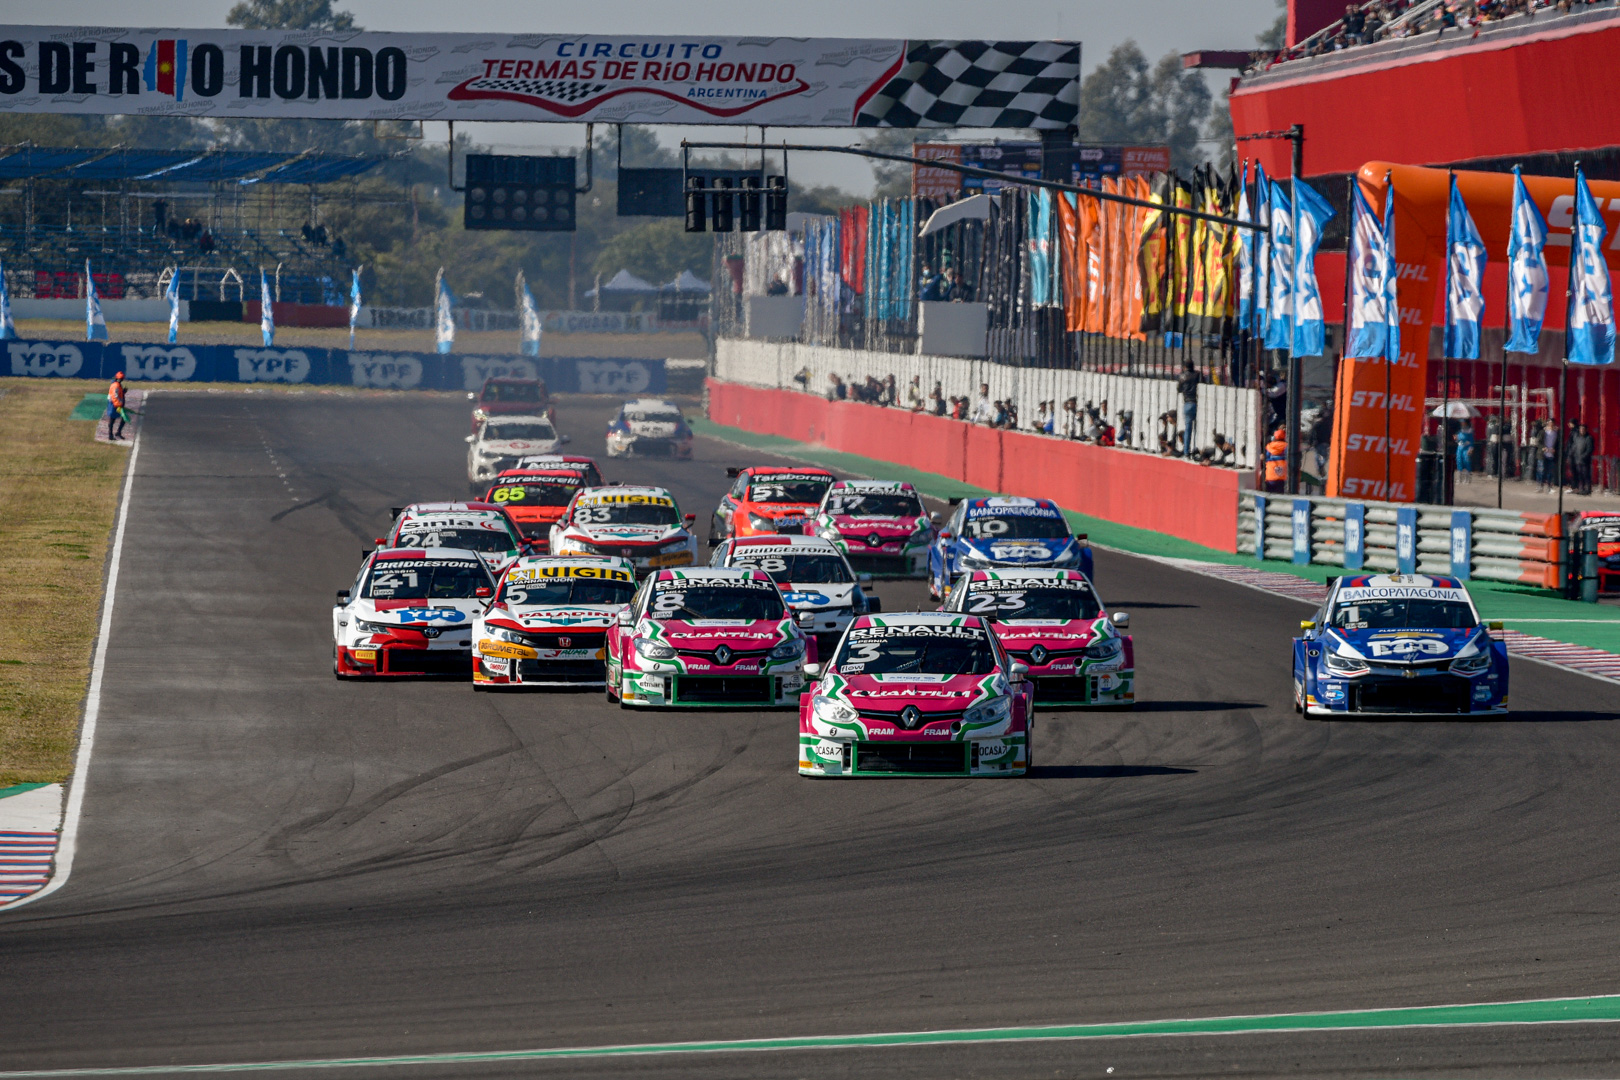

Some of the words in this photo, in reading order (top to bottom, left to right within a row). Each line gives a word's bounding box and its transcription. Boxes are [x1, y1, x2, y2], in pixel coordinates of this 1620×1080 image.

[556, 42, 723, 59] CIRCUITO
[39, 41, 97, 95] DE
[240, 45, 407, 100] HONDO
[482, 59, 598, 79] TERMAS
[602, 61, 638, 80] DE
[695, 62, 796, 83] HONDO
[687, 88, 768, 98] ARGENTINA
[21, 351, 74, 371] YPF
[134, 354, 187, 373] YPF
[248, 356, 300, 375] YPF
[1350, 391, 1416, 412] STIHL
[1346, 433, 1411, 455] STIHL
[493, 486, 526, 502] 65
[753, 486, 784, 498] 51
[1342, 477, 1407, 499] STIHL
[829, 496, 867, 510] 17
[574, 507, 611, 524] 83
[967, 519, 1009, 536] 10
[401, 532, 442, 548] 24
[732, 559, 787, 573] 68
[373, 573, 418, 588] 41
[655, 578, 773, 588] RENAULT
[970, 578, 1089, 589] RENAULT
[504, 585, 528, 605] 5
[654, 593, 685, 611] 8
[968, 593, 1026, 613] 23
[518, 611, 616, 619] PALADINI
[1341, 606, 1359, 623] 1
[671, 631, 773, 639] QUANTIUM
[849, 625, 985, 638] RENAULT
[849, 631, 985, 641] CONCESIONARIOS
[997, 631, 1088, 640] UANTIUM
[847, 643, 881, 663] 3
[851, 689, 971, 698] QUANTIUM
[868, 728, 895, 736] FRAM
[923, 728, 949, 736] FRAM
